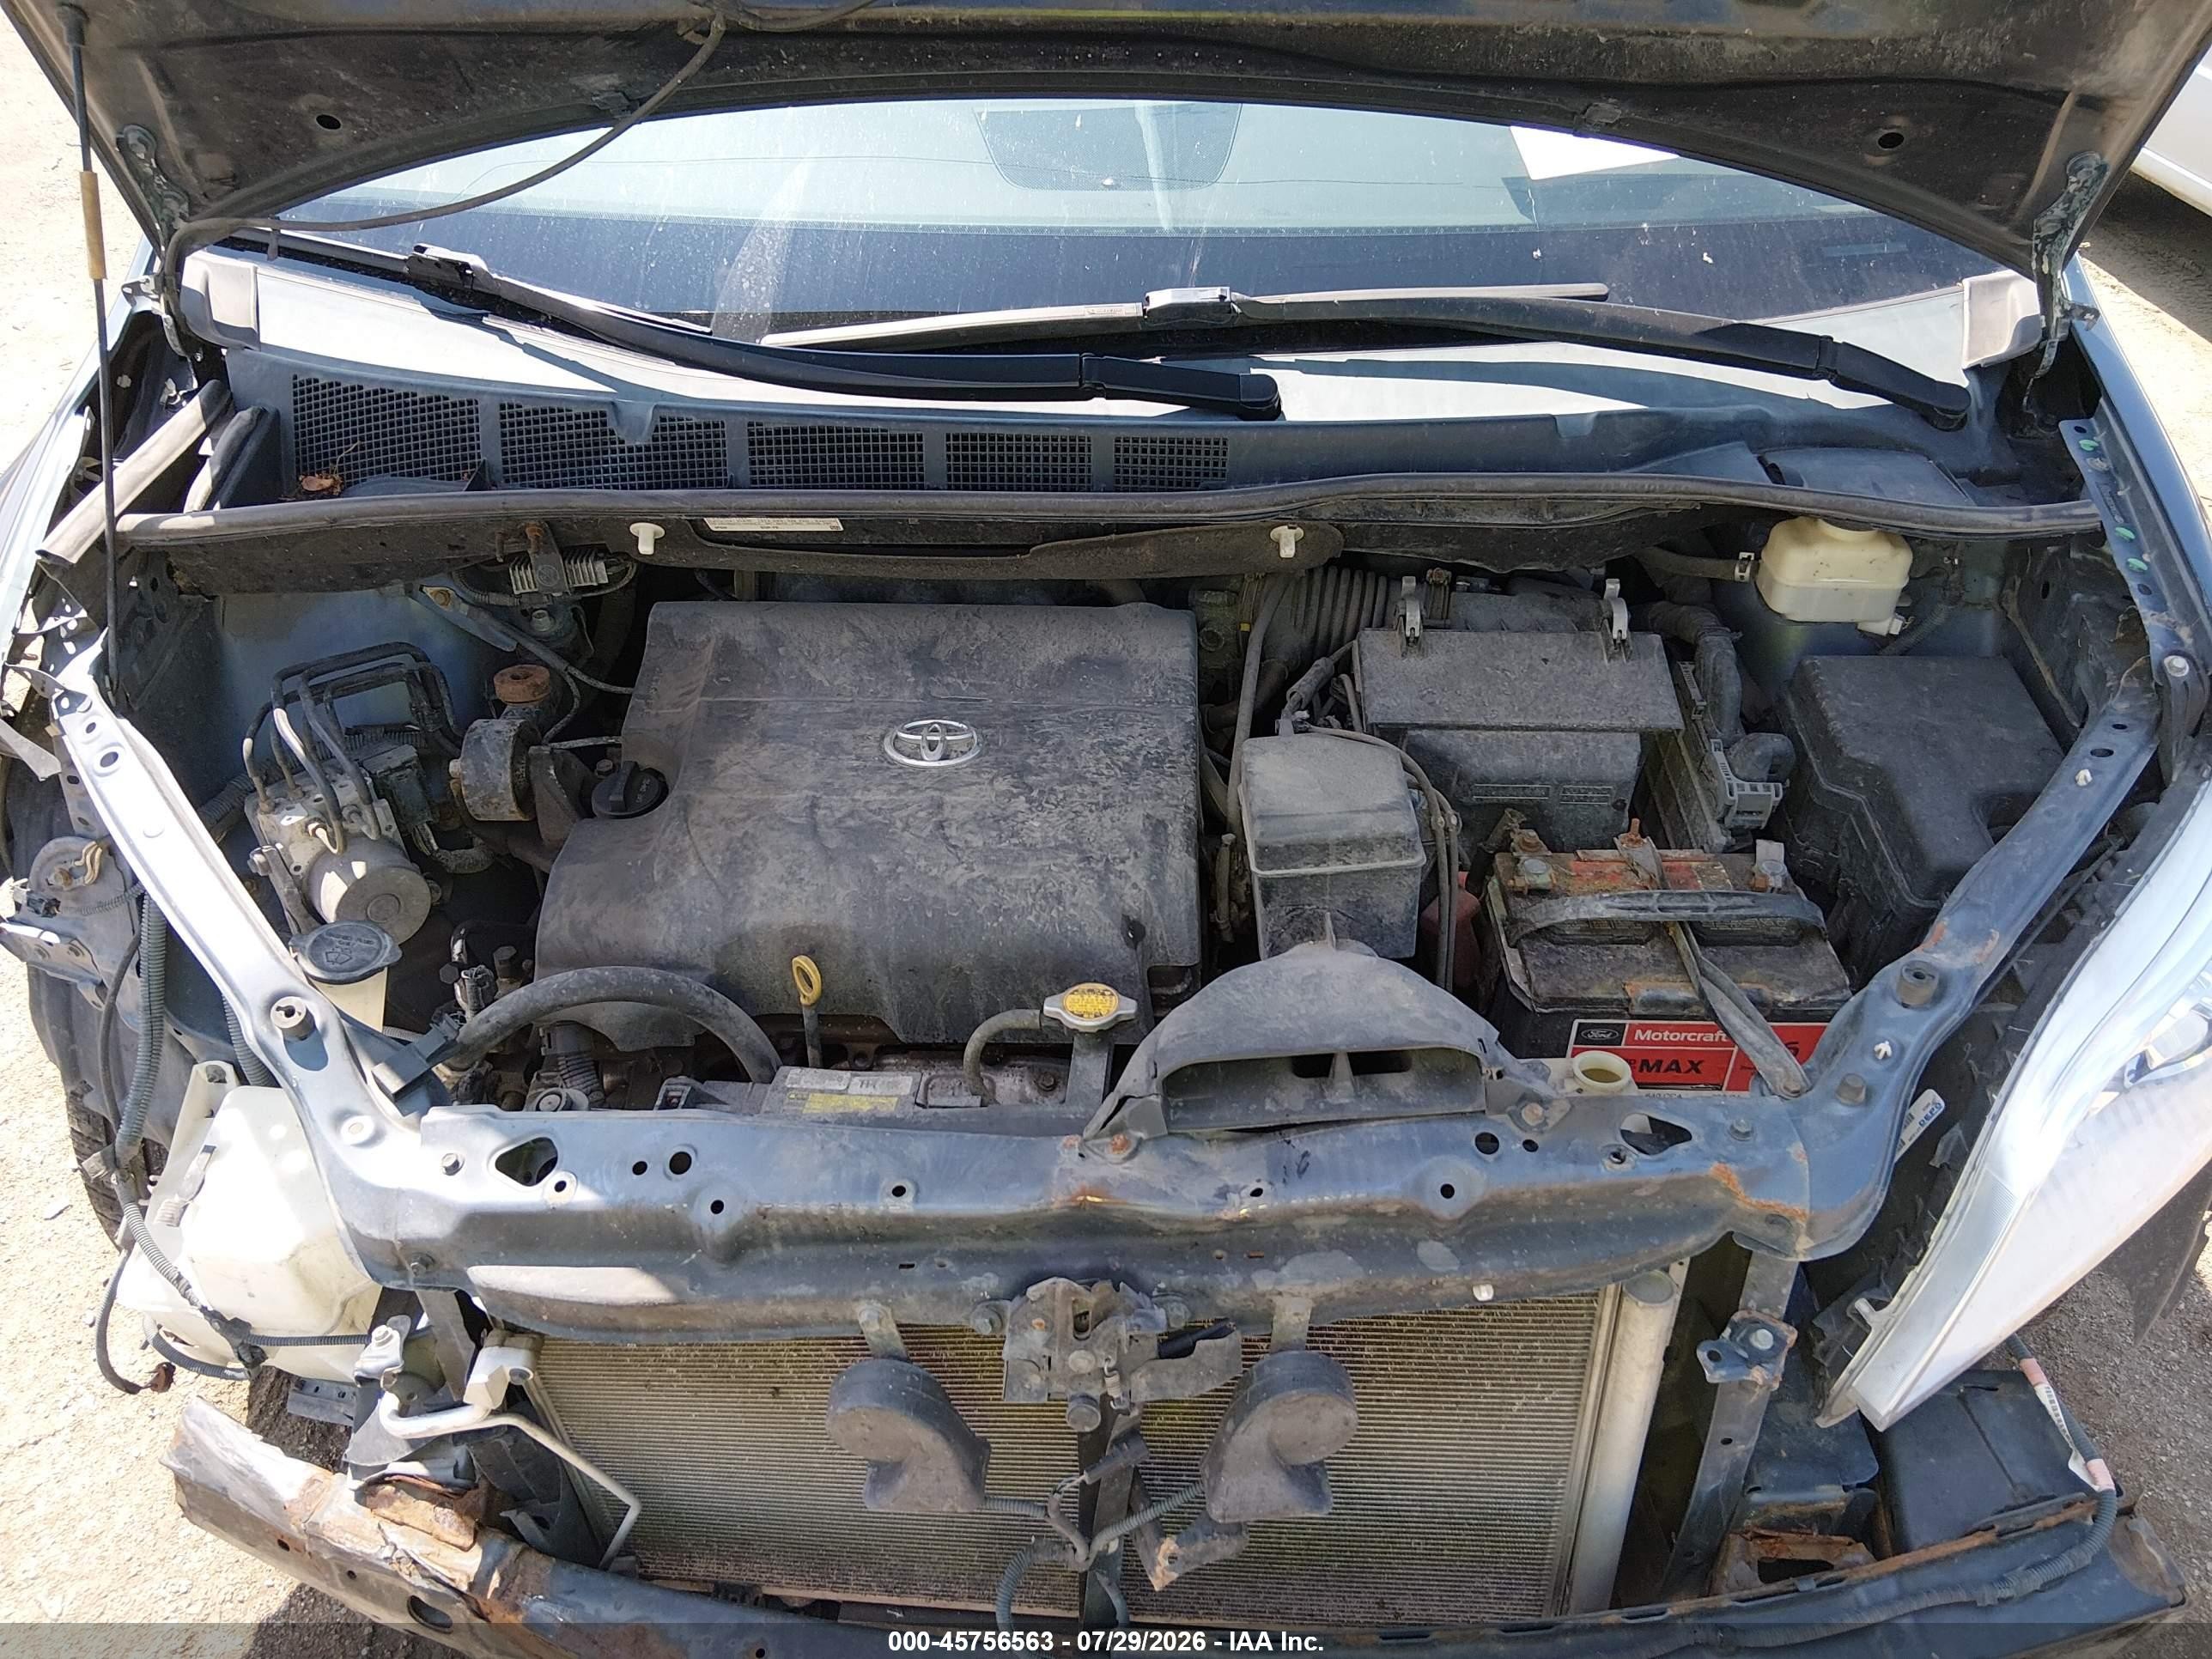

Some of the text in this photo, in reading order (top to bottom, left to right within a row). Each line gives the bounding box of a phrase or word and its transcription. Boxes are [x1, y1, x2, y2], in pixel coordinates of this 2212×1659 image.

[1634, 1030, 1728, 1042] Motorcraft
[1638, 1059, 1704, 1074] MAX
[1918, 1103, 1942, 1127] DEPO
